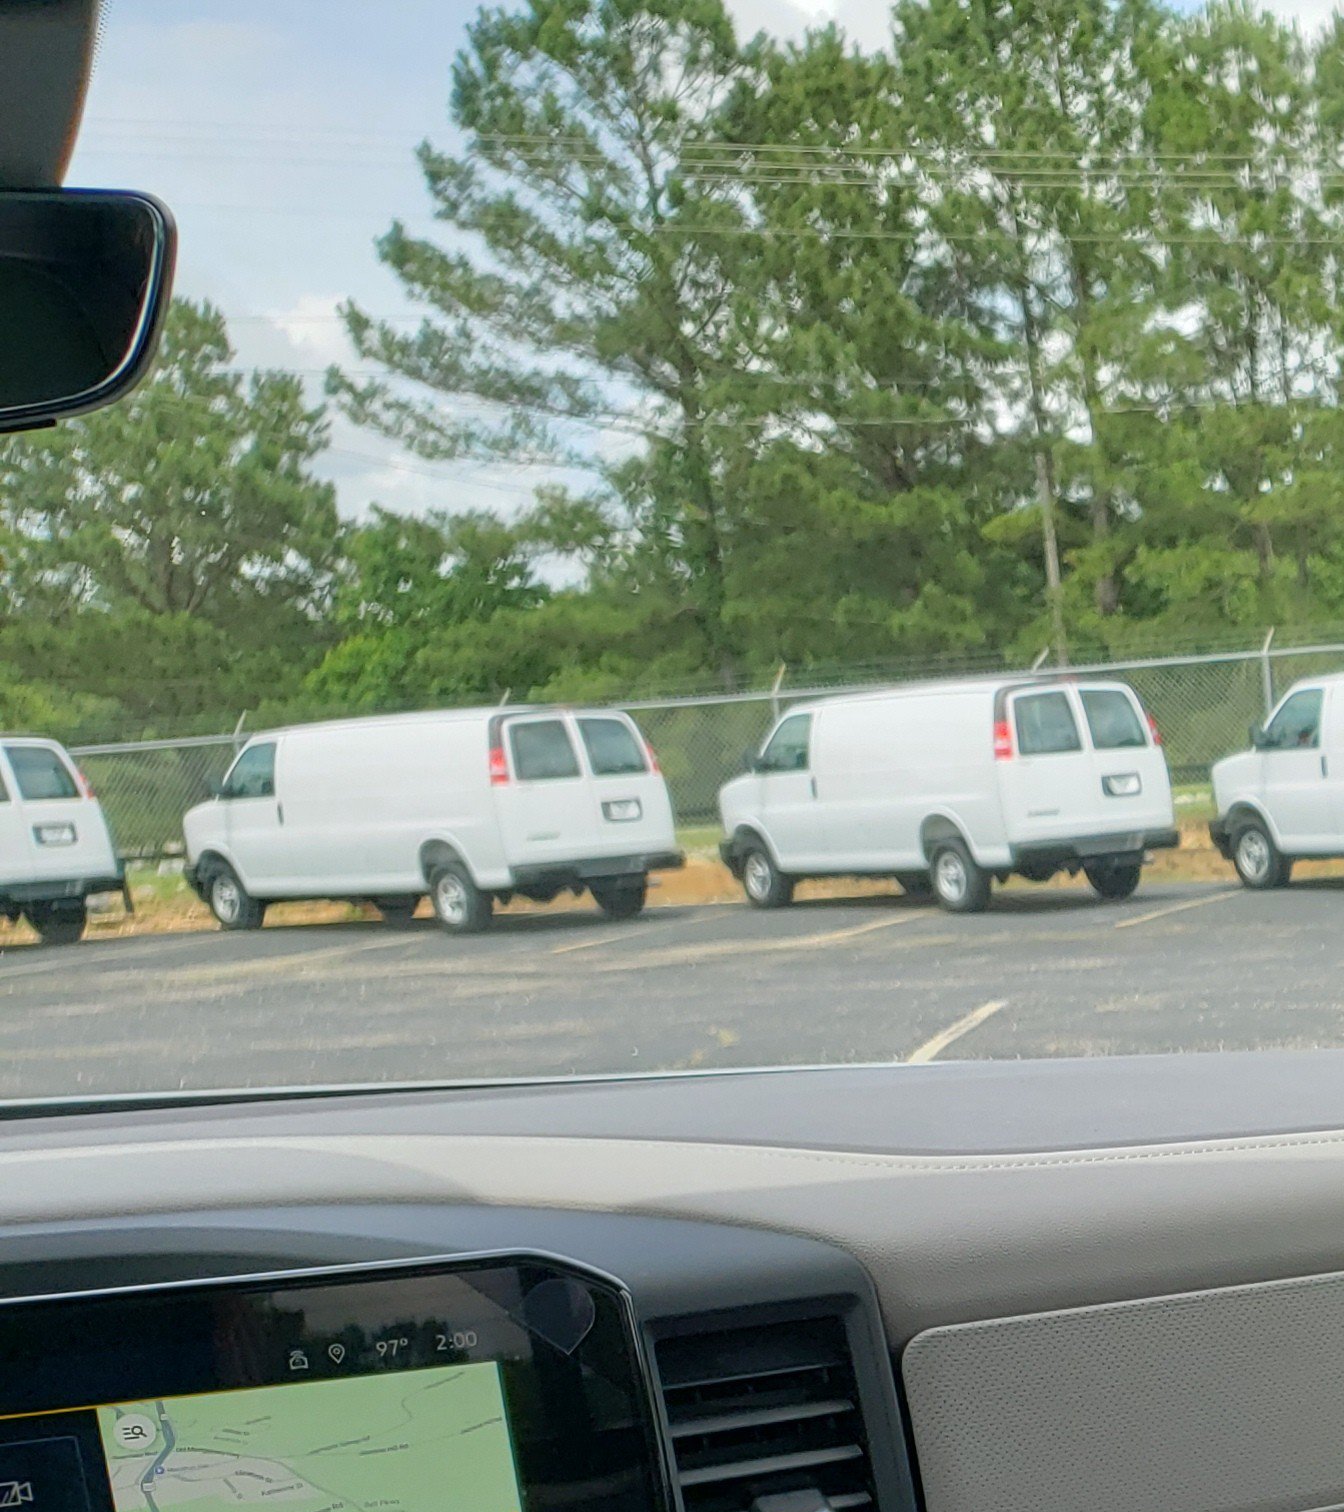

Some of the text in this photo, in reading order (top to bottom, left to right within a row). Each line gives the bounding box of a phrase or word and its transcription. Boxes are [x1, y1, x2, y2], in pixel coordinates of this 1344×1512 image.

[375, 1331, 478, 1357] 97° 2:00
[332, 1501, 344, 1510] Rd
